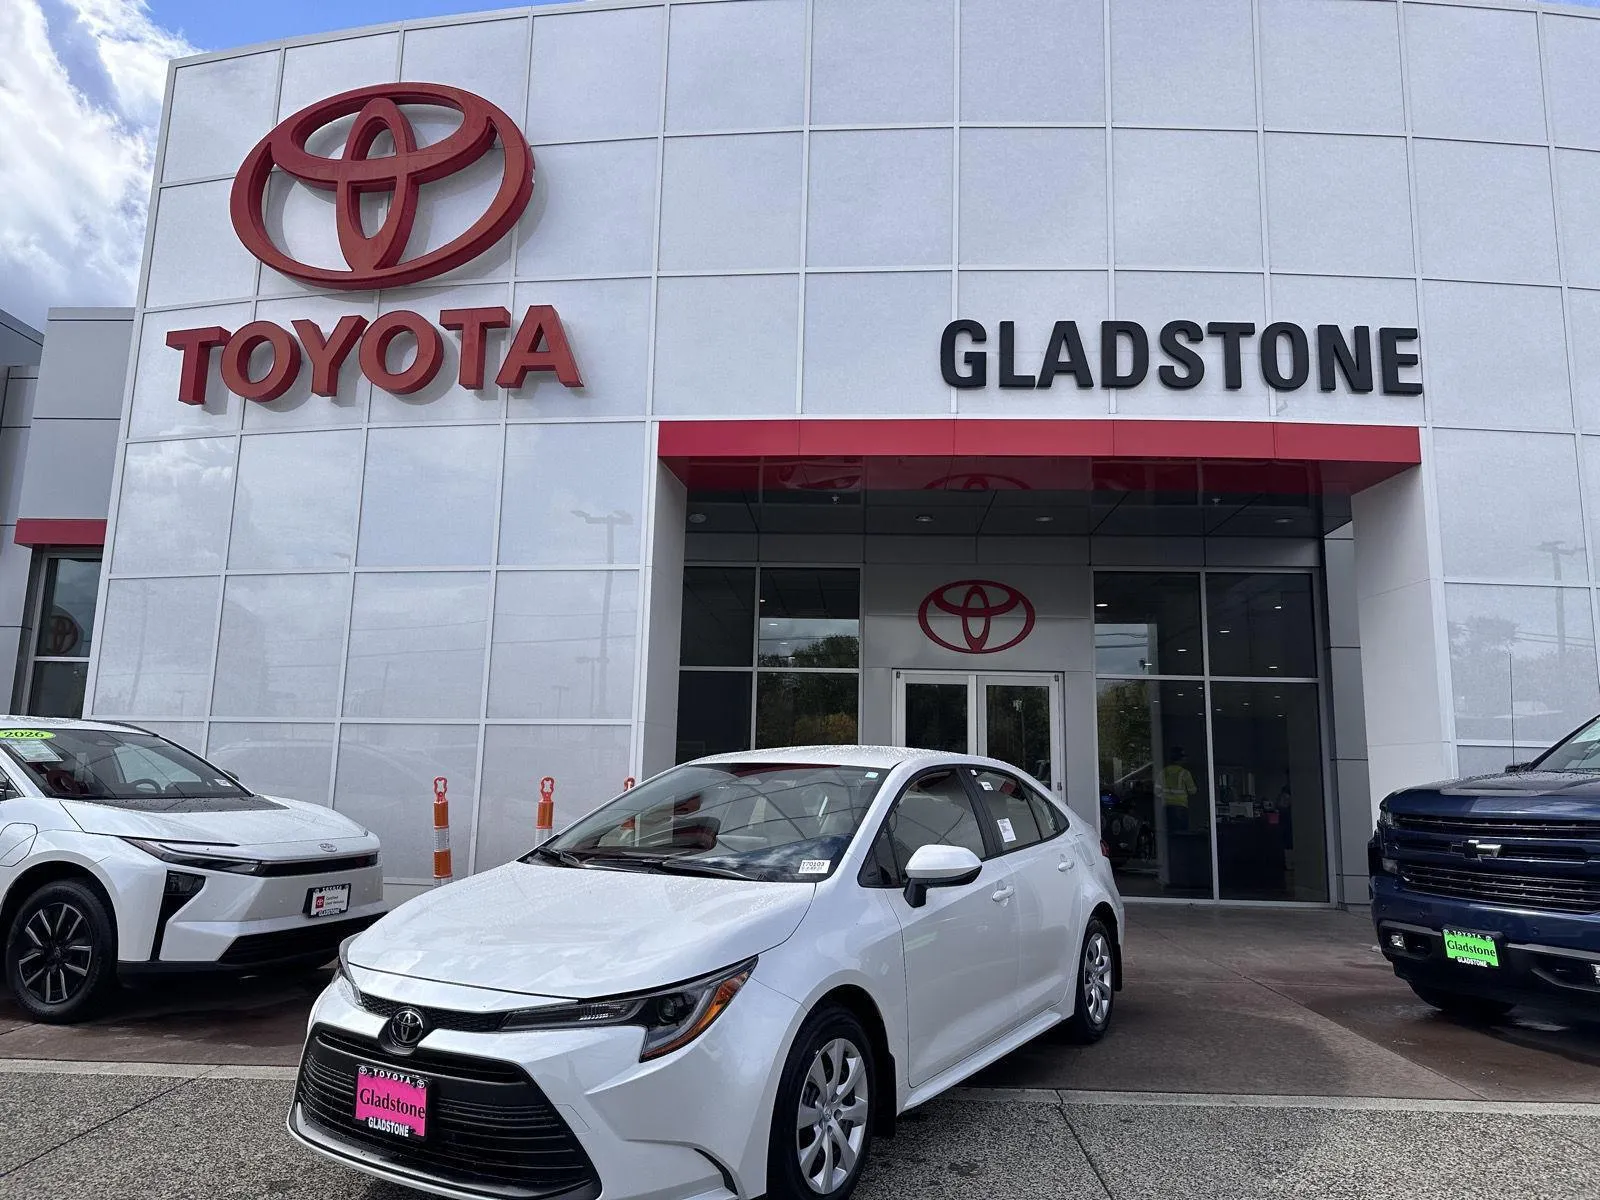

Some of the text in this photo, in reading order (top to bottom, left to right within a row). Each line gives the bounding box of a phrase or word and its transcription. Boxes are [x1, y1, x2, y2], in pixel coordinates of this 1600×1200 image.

[165, 304, 584, 406] TOYOTA
[939, 318, 1424, 396] GLADSTONE
[318, 907, 340, 917] GLADSTONE
[1452, 930, 1482, 939] TOYOTA
[1446, 939, 1496, 957] Gladstone
[1456, 956, 1488, 967] GLADSTONE
[373, 1068, 411, 1085] TOYOTA
[359, 1088, 427, 1120] Gladstone
[367, 1116, 410, 1138] GLADSTONE
